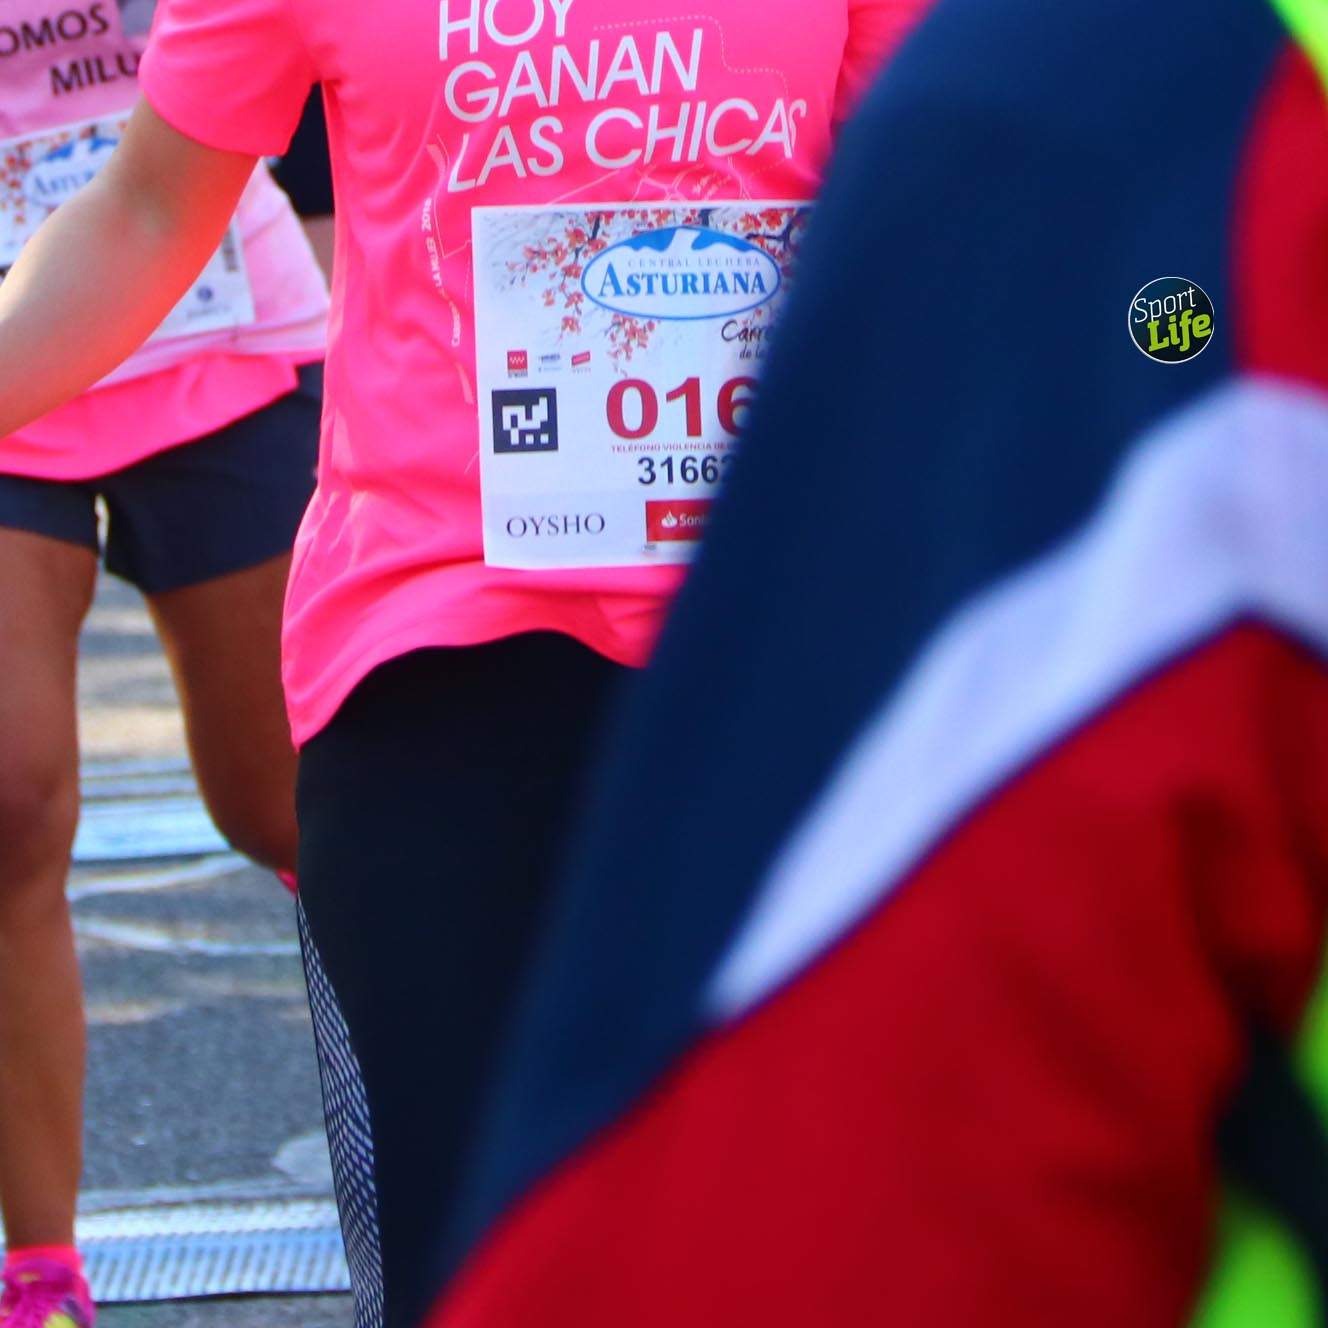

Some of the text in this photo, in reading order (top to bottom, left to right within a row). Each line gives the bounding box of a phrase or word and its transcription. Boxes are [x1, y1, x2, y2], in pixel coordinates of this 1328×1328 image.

[443, 27, 703, 124] GANAN
[446, 115, 564, 193] LAS
[598, 261, 769, 298] ASTURIANA
[606, 375, 759, 440] 016
[506, 512, 606, 539] OYSHO
